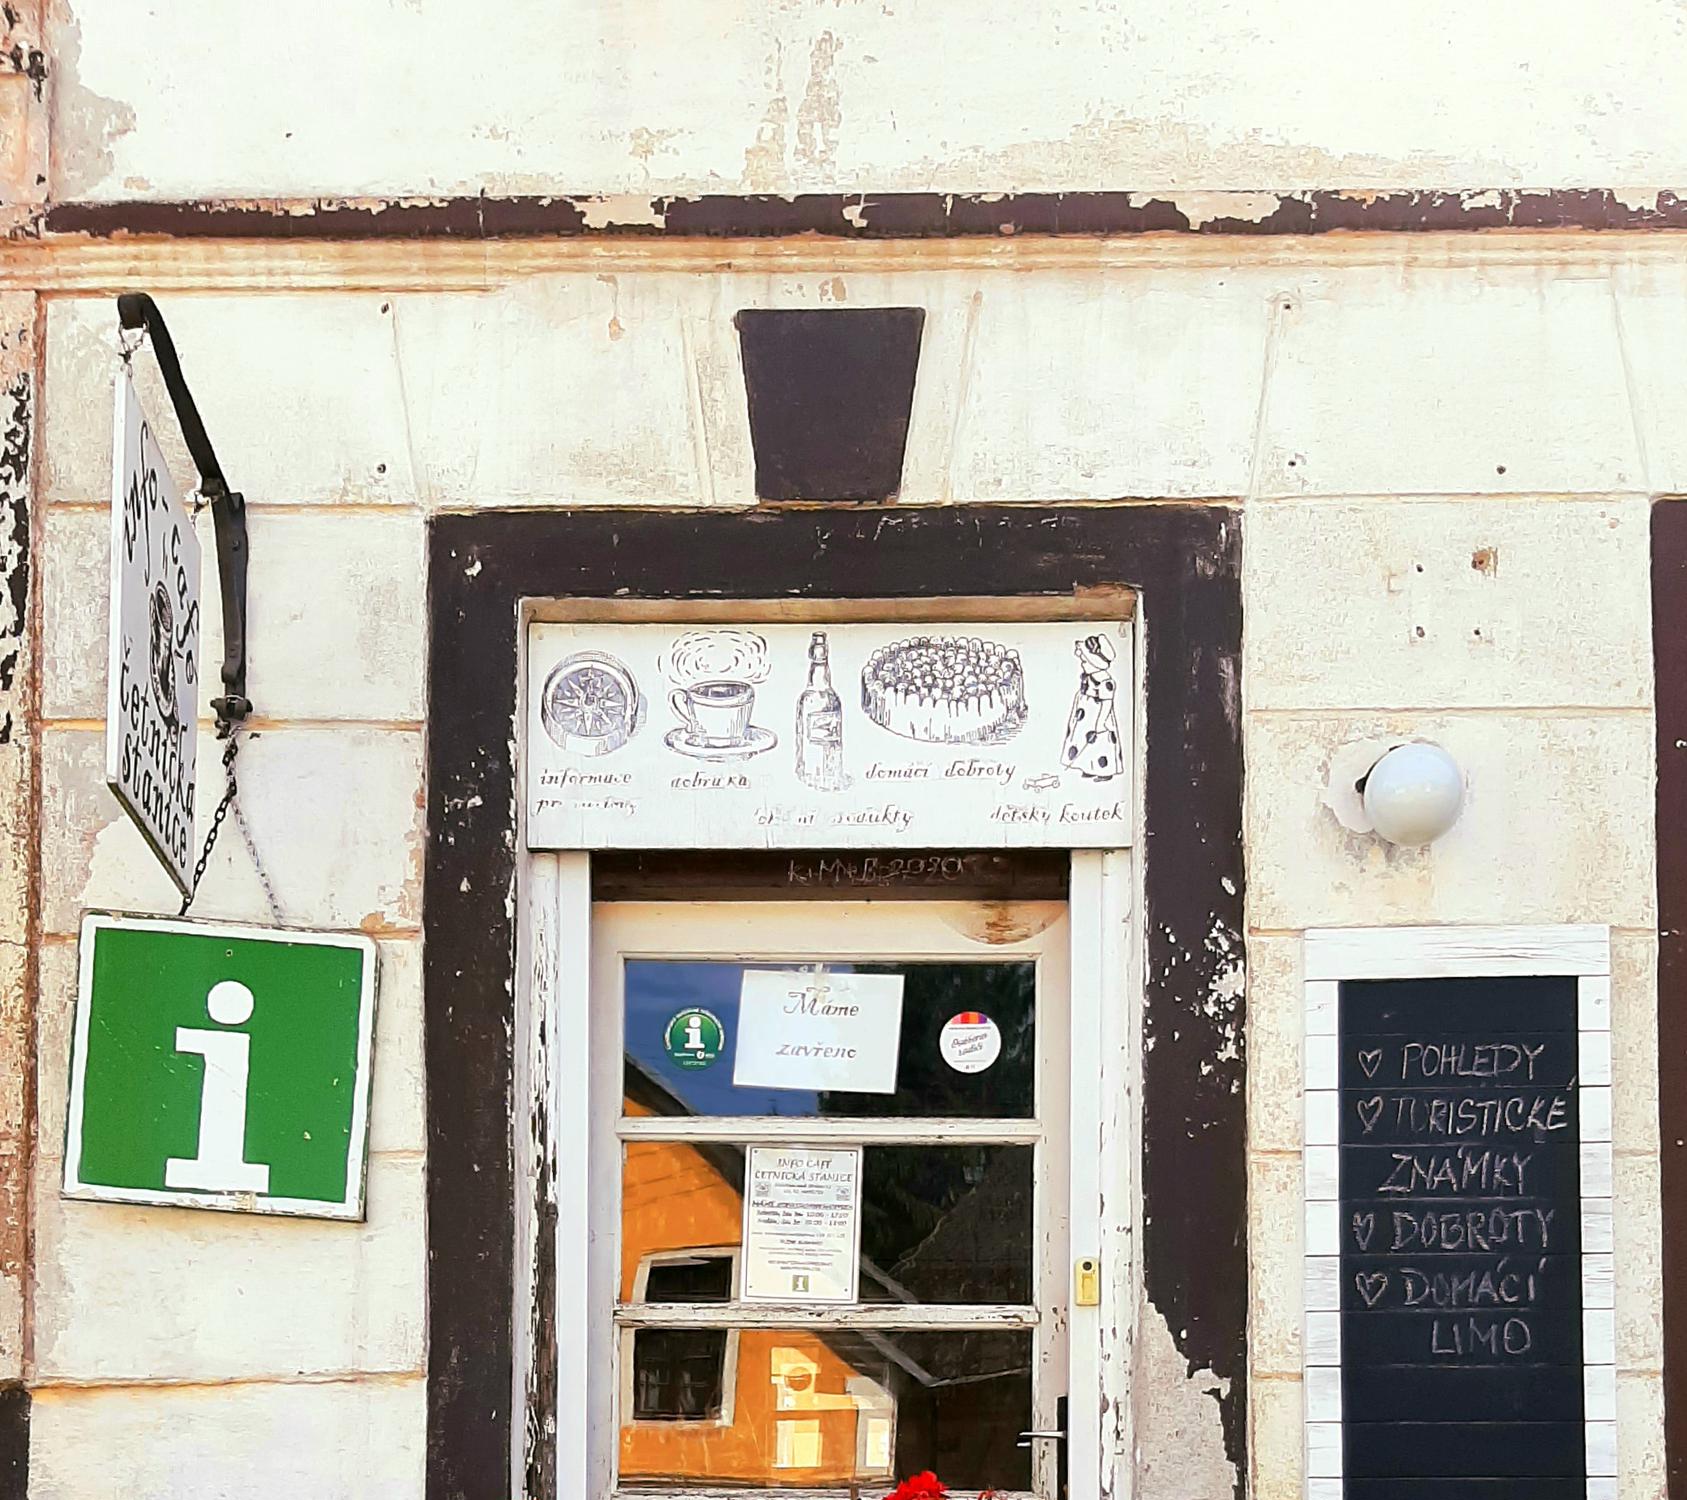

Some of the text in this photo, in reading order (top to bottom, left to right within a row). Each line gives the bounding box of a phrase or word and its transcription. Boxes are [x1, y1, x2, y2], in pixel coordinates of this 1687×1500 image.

[119, 632, 196, 824] četnická
[944, 758, 1017, 786] dobroty
[121, 732, 187, 869] stanice
[1058, 798, 1127, 824] koutek
[783, 985, 860, 1017] Máme
[1401, 1043, 1545, 1080] POHLEDY
[1389, 1207, 1556, 1252] DOBROTY
[1431, 1317, 1533, 1356] LIMO
